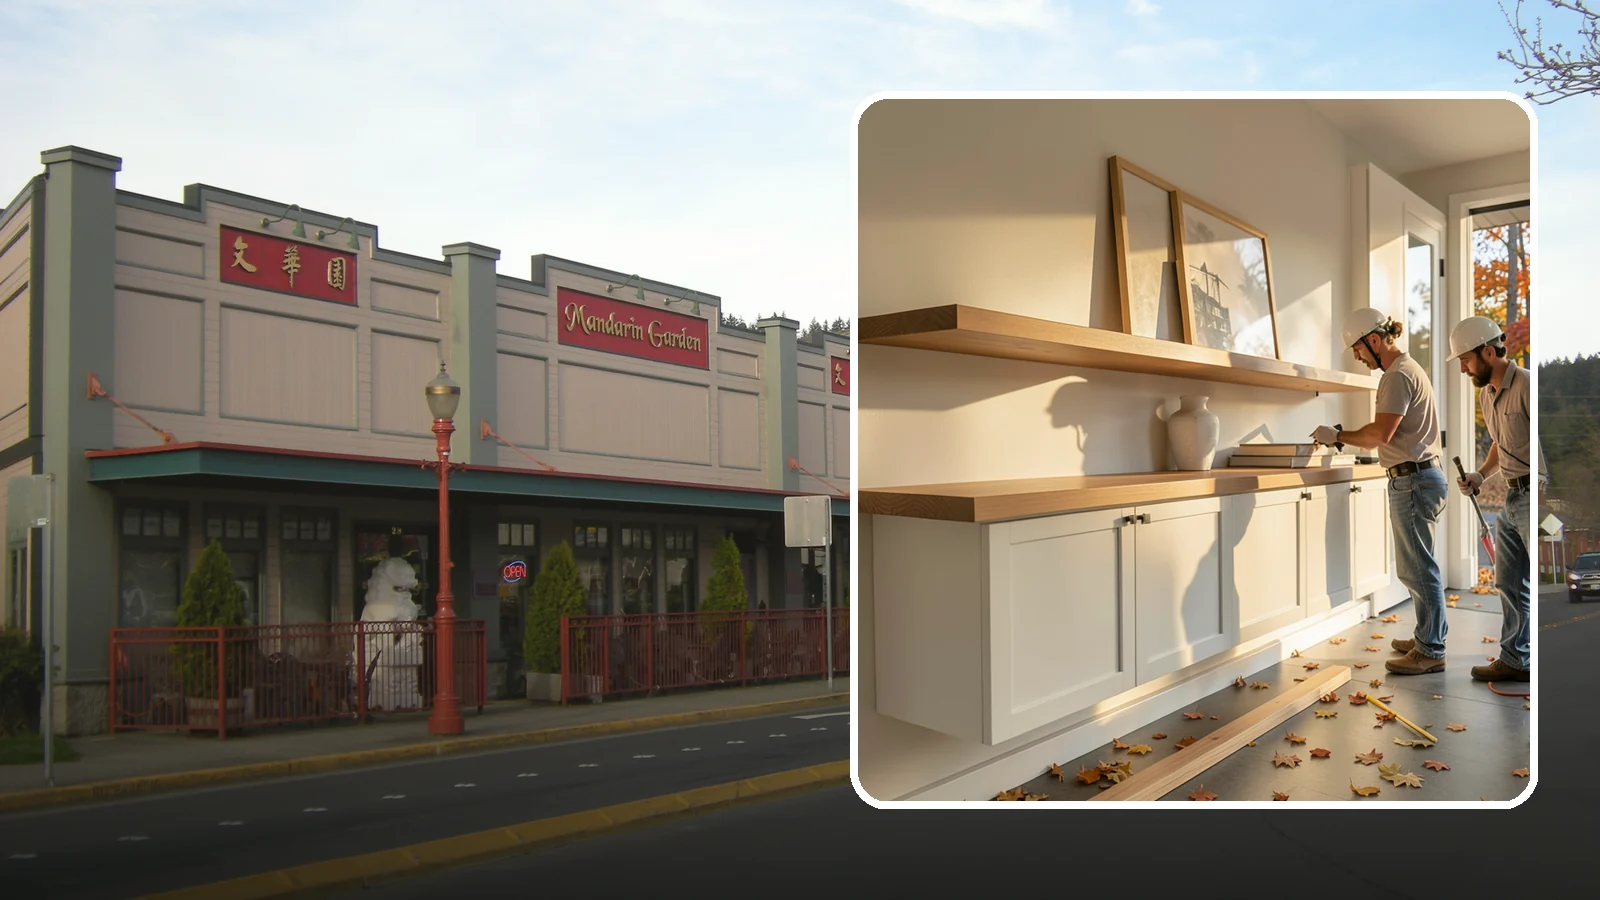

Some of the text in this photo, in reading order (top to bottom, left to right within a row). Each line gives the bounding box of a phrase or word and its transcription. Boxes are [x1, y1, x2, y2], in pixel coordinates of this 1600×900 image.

[564, 301, 702, 352] Mandarin Garden
[503, 565, 526, 578] OPEN
